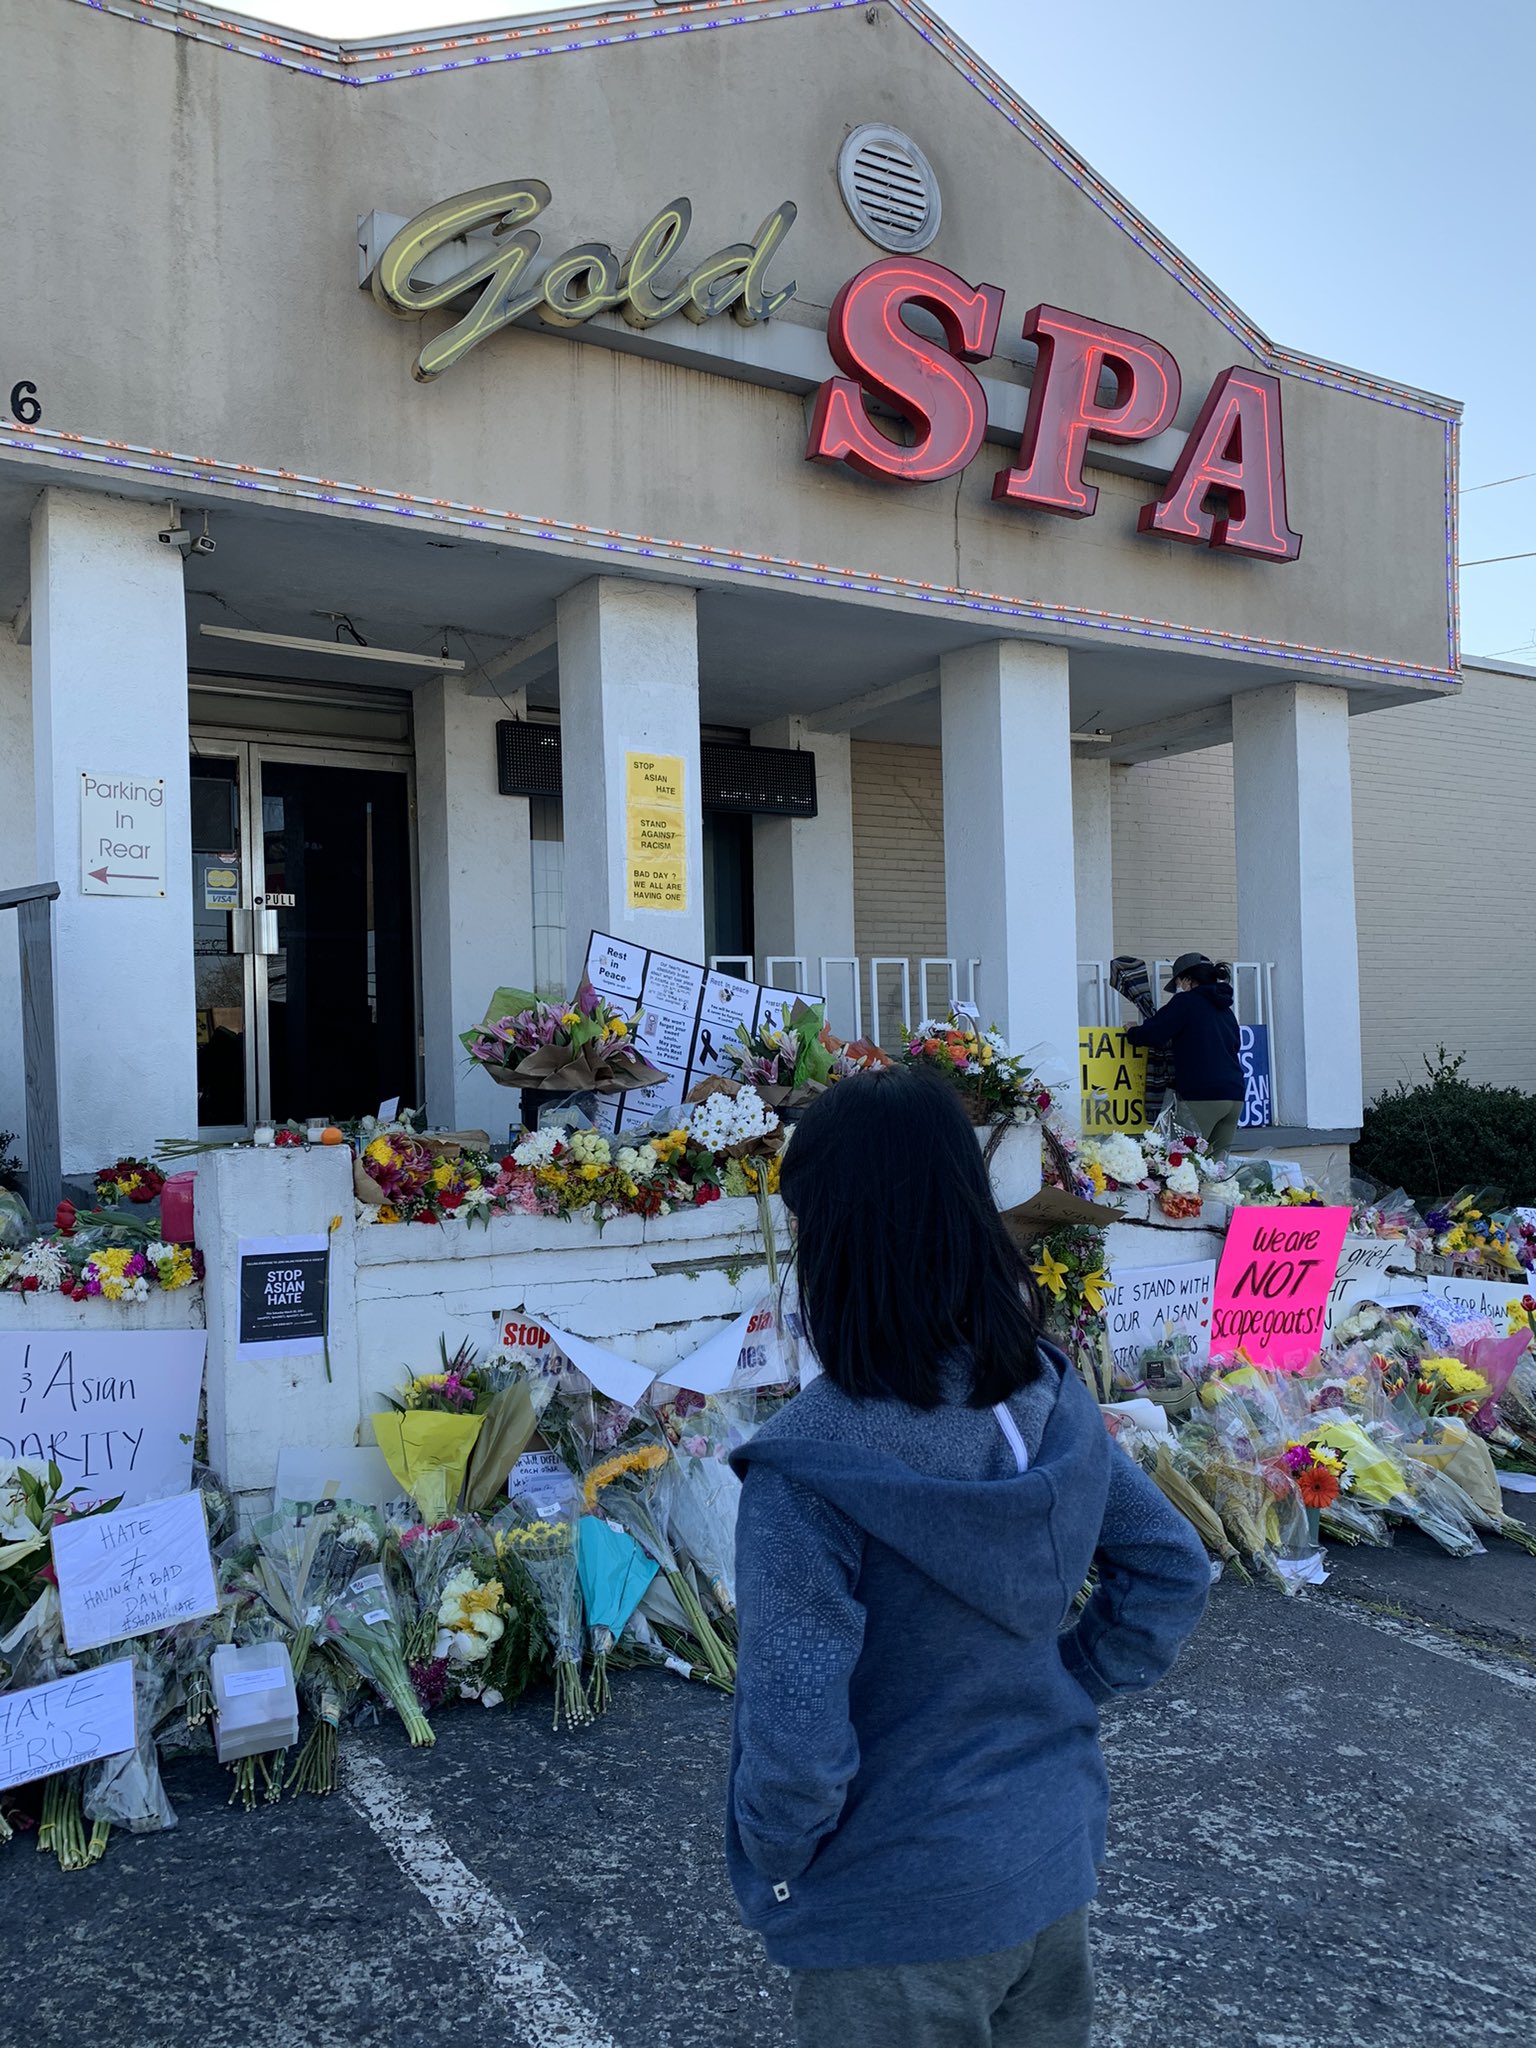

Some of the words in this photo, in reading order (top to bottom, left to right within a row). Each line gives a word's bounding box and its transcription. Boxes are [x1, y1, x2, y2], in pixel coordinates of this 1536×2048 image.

[371, 177, 797, 384] Gold
[805, 255, 1303, 565] SPA
[10, 380, 42, 425] 6
[633, 761, 655, 770] STOP
[644, 774, 668, 783] ASIAN
[85, 778, 163, 807] Parking
[656, 785, 676, 795] HATE
[115, 810, 134, 829] In
[640, 819, 667, 829] STAND
[641, 830, 676, 839] AGAINST
[99, 838, 151, 860] Rear
[641, 841, 671, 850] RACISM
[633, 869, 650, 878] BAD
[653, 871, 669, 880] DAY
[633, 881, 646, 889] WE
[649, 882, 664, 890] ALL
[666, 883, 682, 891] ARE
[212, 895, 232, 903] VISA
[265, 894, 294, 906] PULL
[633, 891, 662, 900] HAVING
[665, 893, 681, 901] ONE
[607, 947, 627, 961] Rest
[610, 959, 619, 969] in
[599, 967, 627, 983] Peace
[1113, 1064, 1132, 1091] A
[1244, 1074, 1269, 1102] AN
[1081, 1099, 1143, 1126] IRUS
[1237, 1099, 1270, 1127] USE
[267, 1269, 302, 1283] STOP
[1231, 1260, 1324, 1299] NOT
[264, 1280, 305, 1294] ASIAN
[1103, 1286, 1125, 1306] WE
[1133, 1279, 1176, 1302] STAND
[1180, 1275, 1210, 1296] WITH
[267, 1292, 302, 1306] HATE
[1480, 1293, 1509, 1318] ASIAN
[1113, 1310, 1140, 1333] OUR
[503, 1322, 551, 1350] Stop
[43, 1351, 136, 1412] Asian
[100, 1519, 152, 1549] HATE
[83, 1580, 131, 1610] HAVING
[137, 1576, 144, 1589] A
[149, 1564, 183, 1587] BAD
[0, 1721, 102, 1775] IRUS
